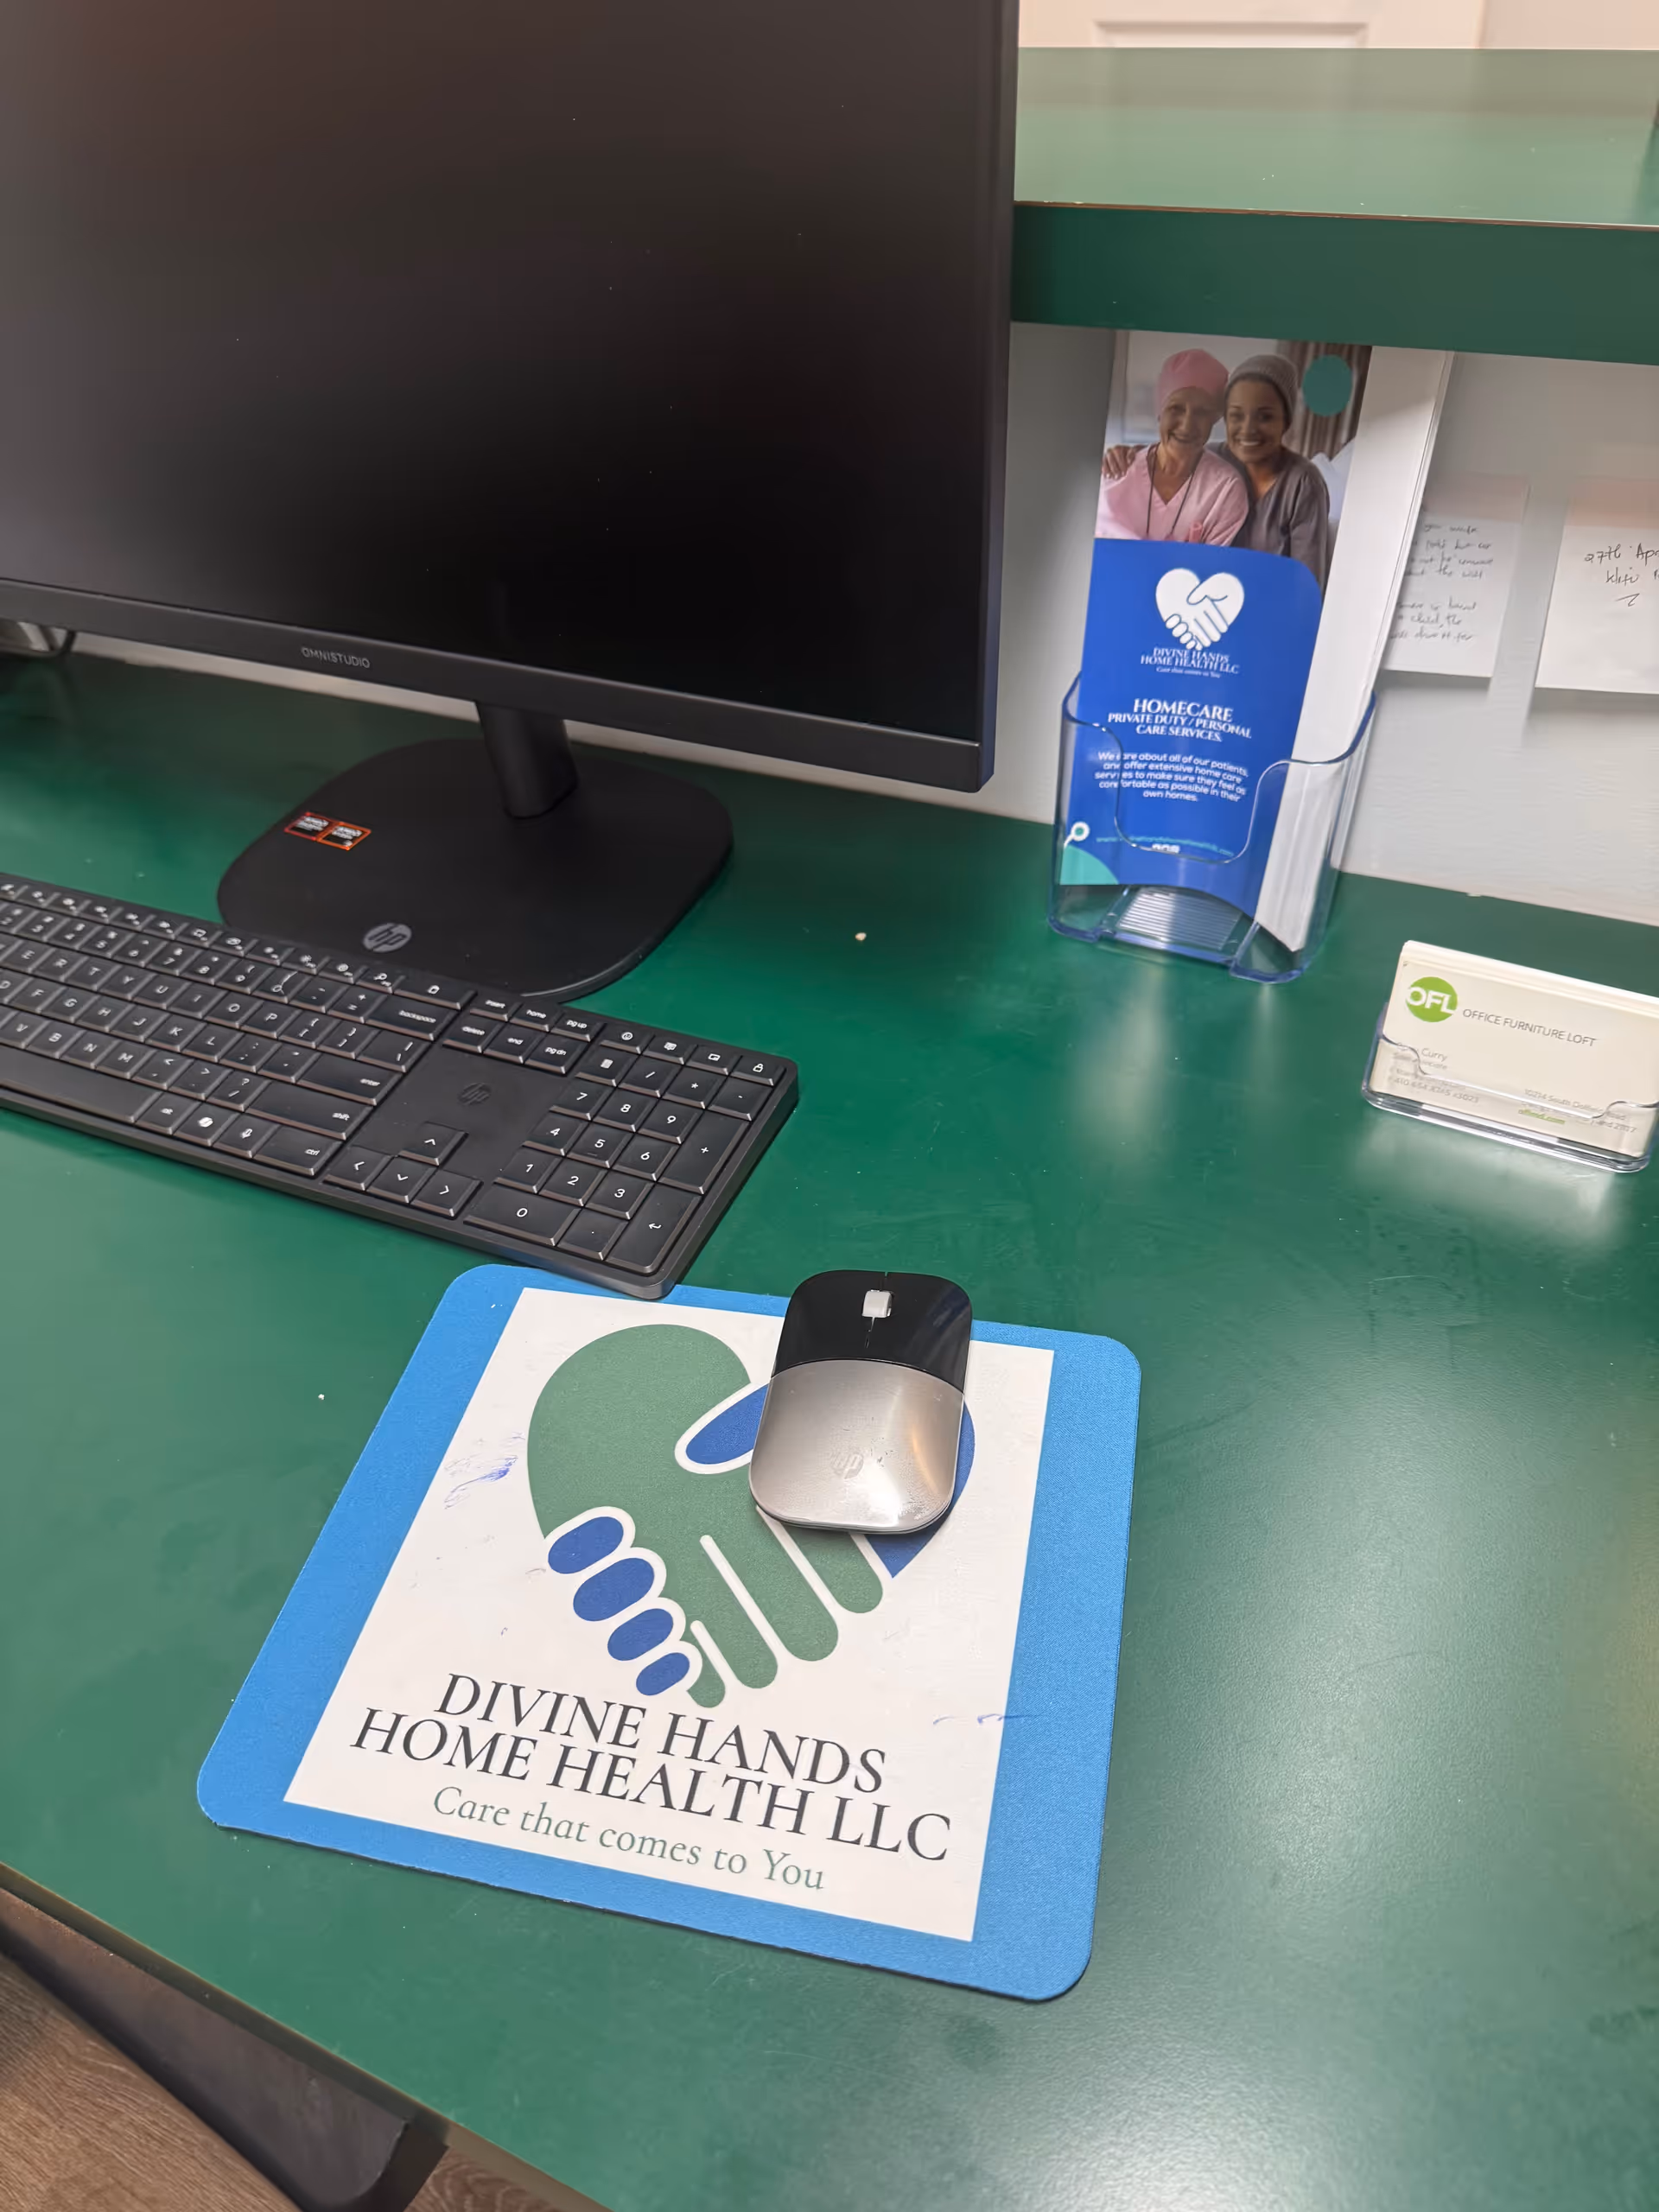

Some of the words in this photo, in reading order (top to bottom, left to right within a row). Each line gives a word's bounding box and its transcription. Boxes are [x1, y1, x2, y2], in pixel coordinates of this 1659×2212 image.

[301, 646, 370, 668] OMNISTUDIO
[1154, 647, 1189, 658] DIVINE
[1192, 650, 1230, 664] HANDS
[1141, 655, 1173, 665] HOME
[1219, 663, 1239, 674] LLC
[1134, 698, 1234, 722] HOMECARE
[1108, 713, 1154, 724] PRIVATE
[1154, 715, 1188, 726] DUTY
[1196, 720, 1252, 739] PERSONAL
[1136, 724, 1166, 735] CARE
[1098, 752, 1115, 760] We
[1139, 753, 1167, 762] about
[1182, 754, 1193, 764] of
[1193, 757, 1210, 766] our
[1124, 761, 1147, 771] offer
[1148, 762, 1194, 773] extensive
[1195, 766, 1221, 778] home
[1222, 772, 1243, 784] care
[1147, 772, 1173, 781] make
[1174, 773, 1195, 783] sure
[1197, 775, 1217, 789] they
[1218, 779, 1235, 791] feel
[1236, 785, 1246, 795] as
[1143, 790, 1163, 798] own
[1171, 781, 1210, 795] possible
[1210, 785, 1219, 795] in
[1220, 790, 1242, 802] their
[485, 1000, 505, 1008] insert
[1408, 985, 1457, 1015] OFL
[398, 1009, 436, 1023] backspace
[526, 1009, 547, 1019] home
[567, 1020, 576, 1028] pg
[1463, 1008, 1501, 1025] OFFICE
[1503, 1018, 1566, 1040] FURNITURE
[1567, 1032, 1596, 1046] LOFT
[461, 1026, 486, 1036] delete
[360, 1078, 381, 1087] enter
[576, 1092, 588, 1101] 7
[620, 1103, 631, 1113] 8
[332, 1112, 350, 1122] shift
[666, 1116, 677, 1124] 9
[550, 1127, 561, 1136] 4
[594, 1139, 606, 1148] 5
[640, 1151, 650, 1160] 6
[526, 1163, 534, 1173] 1
[567, 1175, 579, 1185] 2
[614, 1188, 626, 1198] 3
[516, 1207, 528, 1217] 0
[434, 1673, 647, 1749] DIVINE
[657, 1712, 886, 1794] HANDS
[350, 1707, 538, 1781] HOME
[546, 1744, 815, 1835] HEALTH
[826, 1795, 951, 1861] LLC
[434, 1786, 511, 1827] Care
[521, 1801, 590, 1843] that
[599, 1826, 702, 1866] comes
[713, 1847, 747, 1874] to
[763, 1848, 824, 1891] You
